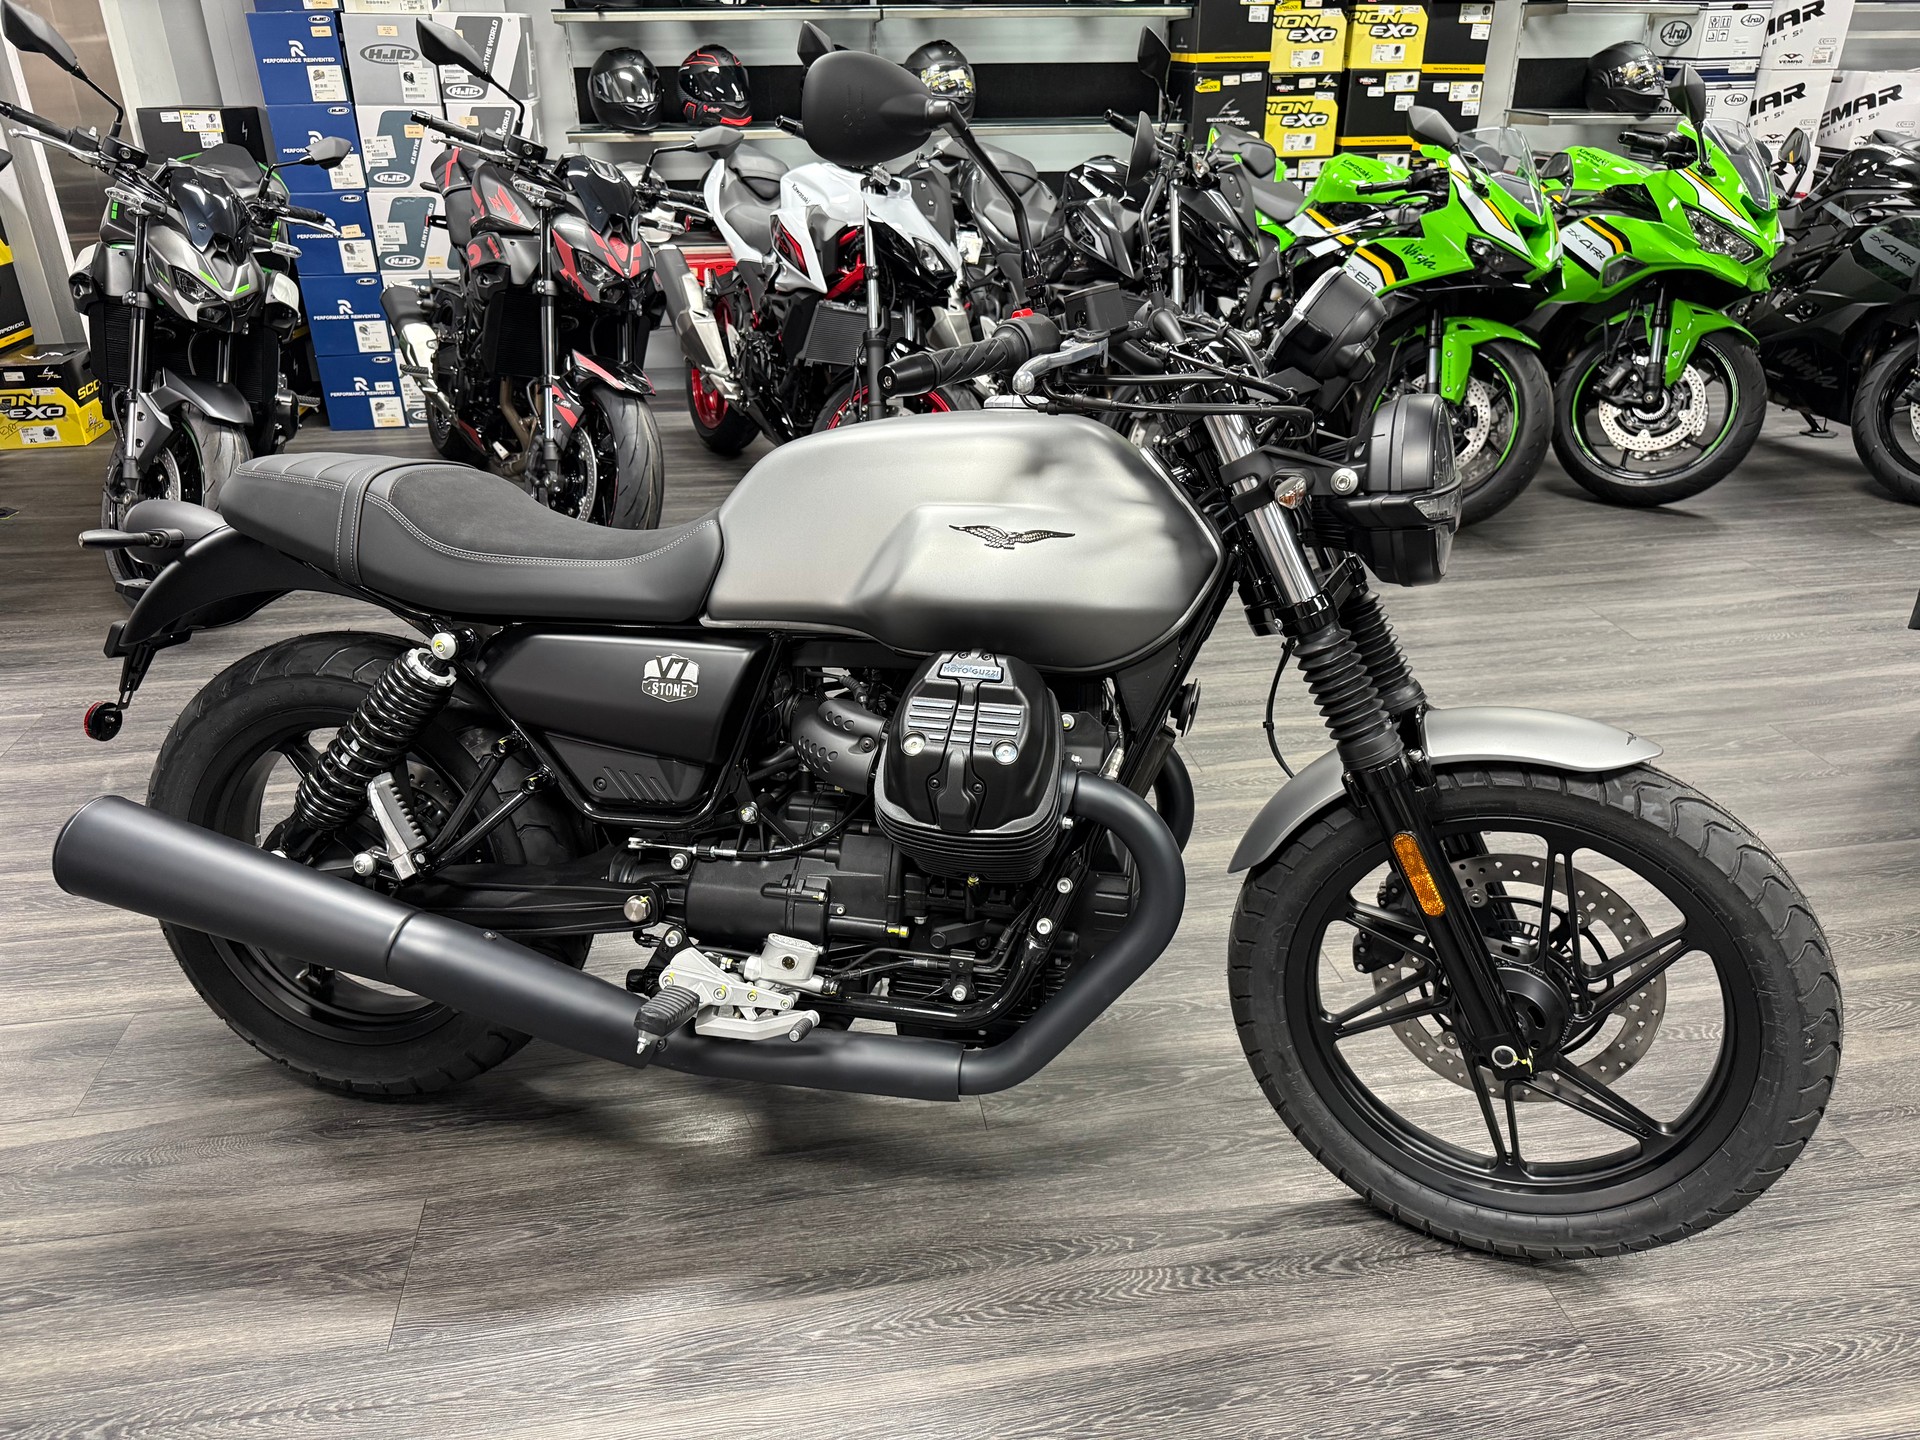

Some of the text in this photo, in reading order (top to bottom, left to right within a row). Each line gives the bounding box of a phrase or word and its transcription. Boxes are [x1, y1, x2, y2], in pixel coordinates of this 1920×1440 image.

[1742, 14, 1762, 24] Arai
[486, 20, 498, 46] WORLD
[1661, 23, 1689, 40] Arai
[368, 48, 411, 60] HJC
[792, 183, 810, 205] Kawasaki
[1401, 243, 1436, 270] Ninja
[656, 656, 689, 679] V7
[943, 665, 1000, 678] MOTO GUZZI
[652, 682, 688, 697] STONE
